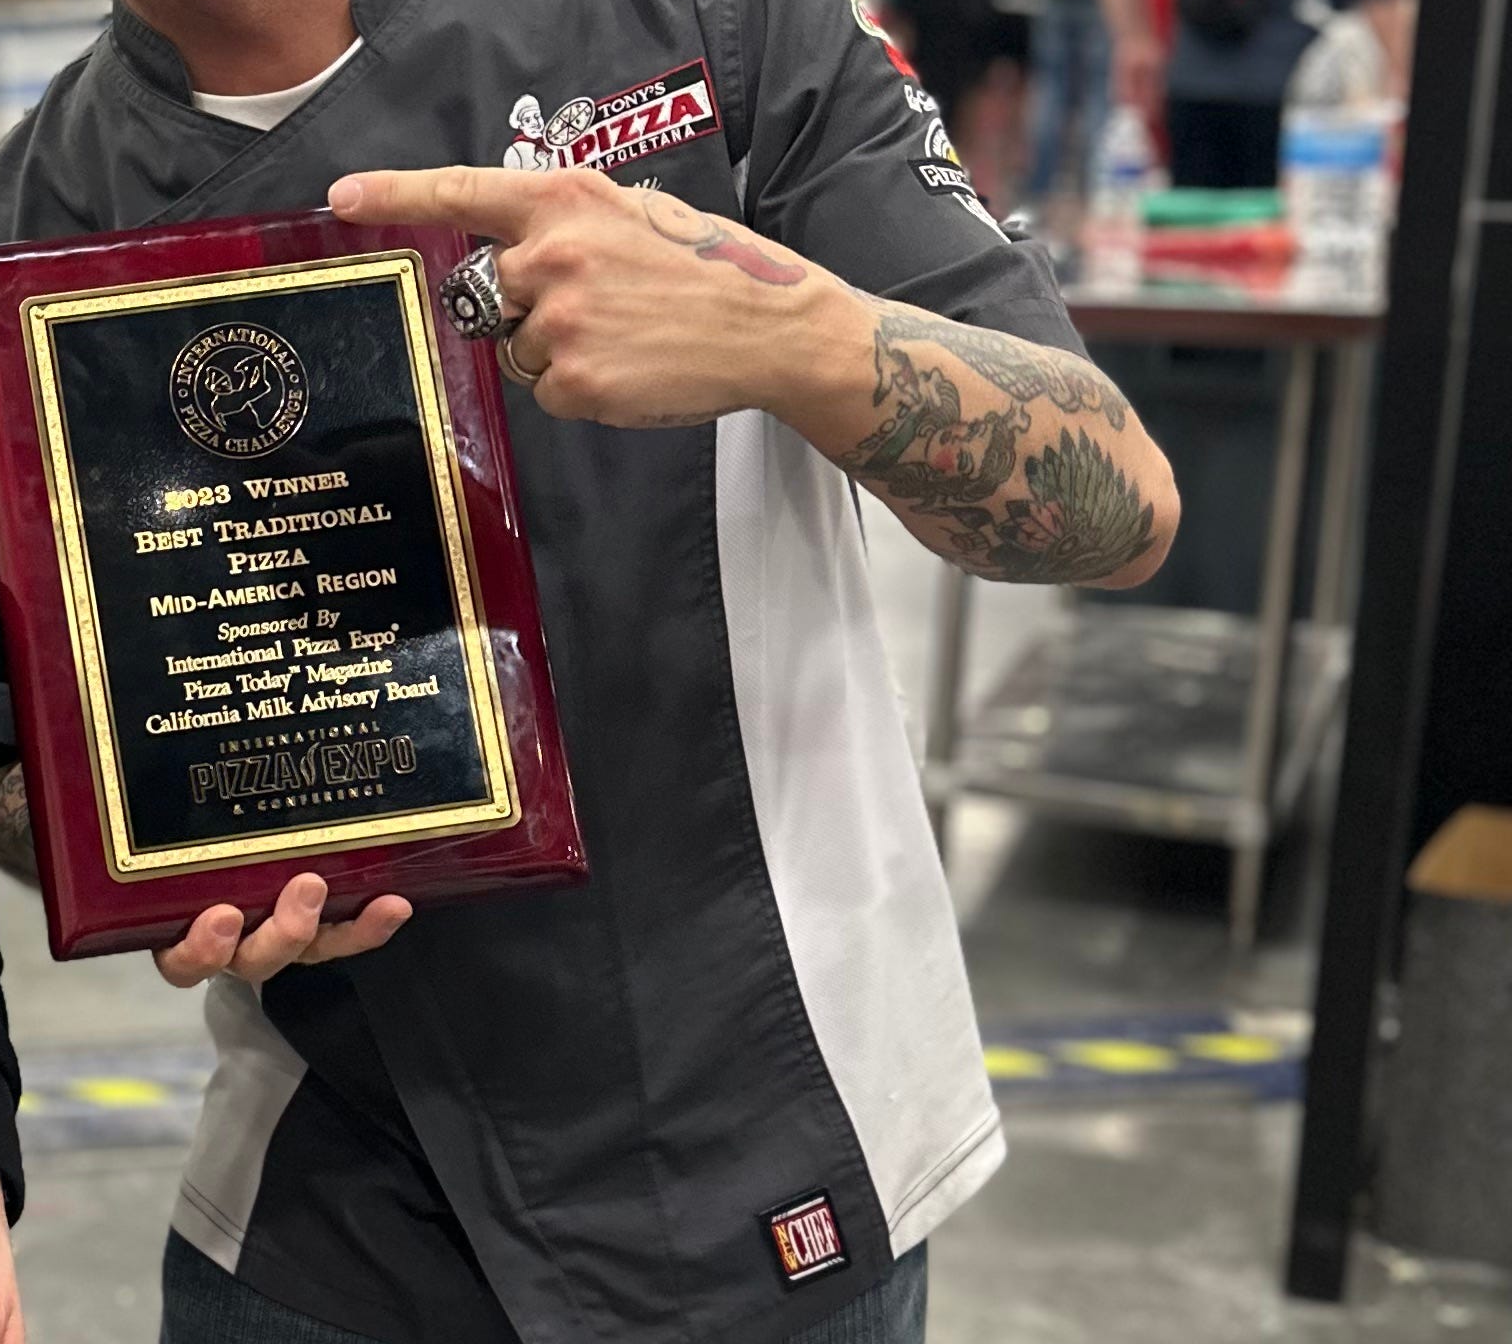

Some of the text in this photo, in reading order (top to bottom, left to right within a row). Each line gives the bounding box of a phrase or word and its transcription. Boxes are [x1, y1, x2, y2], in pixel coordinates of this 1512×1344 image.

[597, 81, 667, 118] TONY'S
[571, 92, 705, 166] PIZZA
[585, 125, 697, 170] APOLETANA
[177, 328, 296, 385] INTERNATIONAL
[179, 389, 303, 453] PIZZA CHALLENGE
[243, 471, 350, 499] WINNER
[134, 503, 392, 553] BEST TRADITIONAL
[227, 547, 311, 575] PIZZA
[149, 567, 397, 617] MID-AMERICA REGION
[217, 609, 341, 643] Sponsored By
[165, 640, 284, 676] International
[292, 637, 339, 657] Pizza
[183, 681, 233, 701] Pizza
[305, 657, 393, 685] Magazine
[145, 675, 441, 735] California Milk Advisory Board
[219, 721, 381, 754] INTERNATIONAL
[189, 734, 417, 804] PIZZA EXPO
[233, 803, 245, 815] &
[788, 1207, 837, 1266] CHEF
